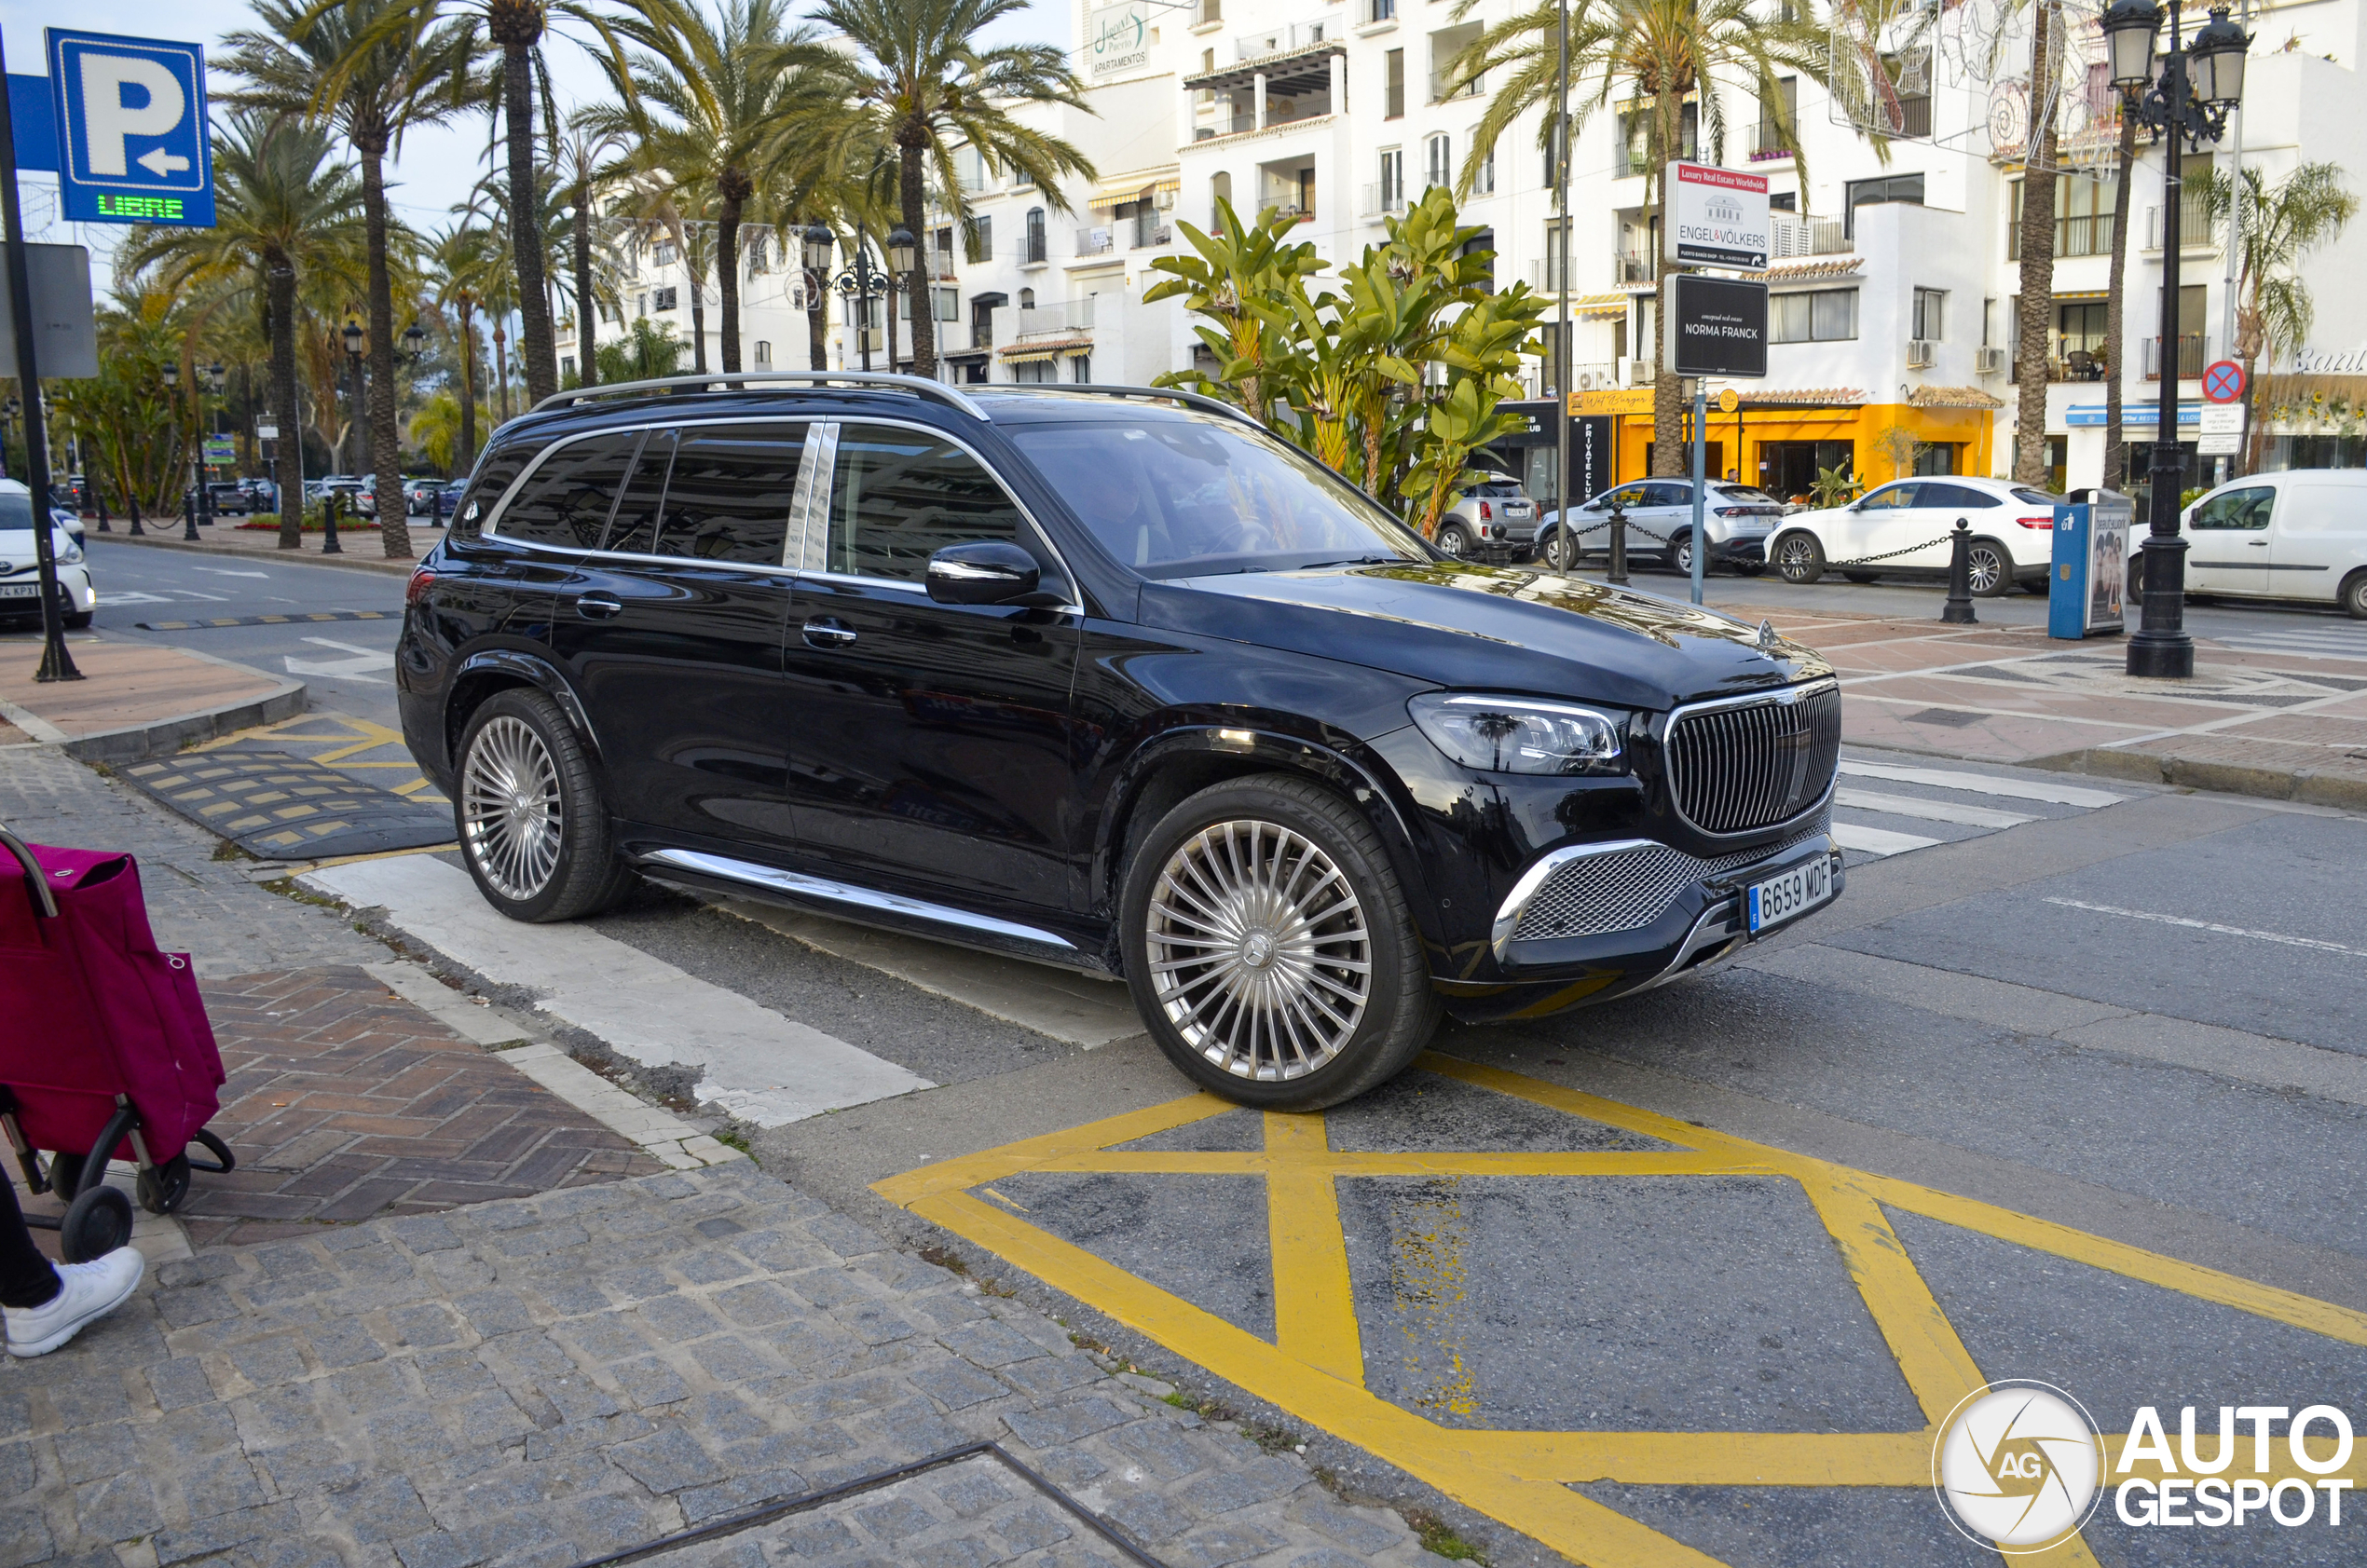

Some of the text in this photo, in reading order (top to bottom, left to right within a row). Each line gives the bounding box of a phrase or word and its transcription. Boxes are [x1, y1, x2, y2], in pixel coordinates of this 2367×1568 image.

[1108, 39, 1132, 52] Puerto
[1094, 51, 1145, 74] APARTAMENTOS
[79, 52, 185, 176] P
[1681, 169, 1766, 190] Luxury Real Estate Worldwide
[98, 195, 184, 219] LIBRE
[1680, 225, 1766, 248] ENGEL&VÖLKERS
[1685, 322, 1758, 339] NORMA FRANCK
[1606, 392, 1648, 407] Burger
[2096, 514, 2126, 530] beautywork
[14, 586, 33, 594] KPX
[1290, 806, 1354, 855] ZERO
[1762, 861, 1827, 920] 6659 MDF
[1752, 913, 1758, 923] E
